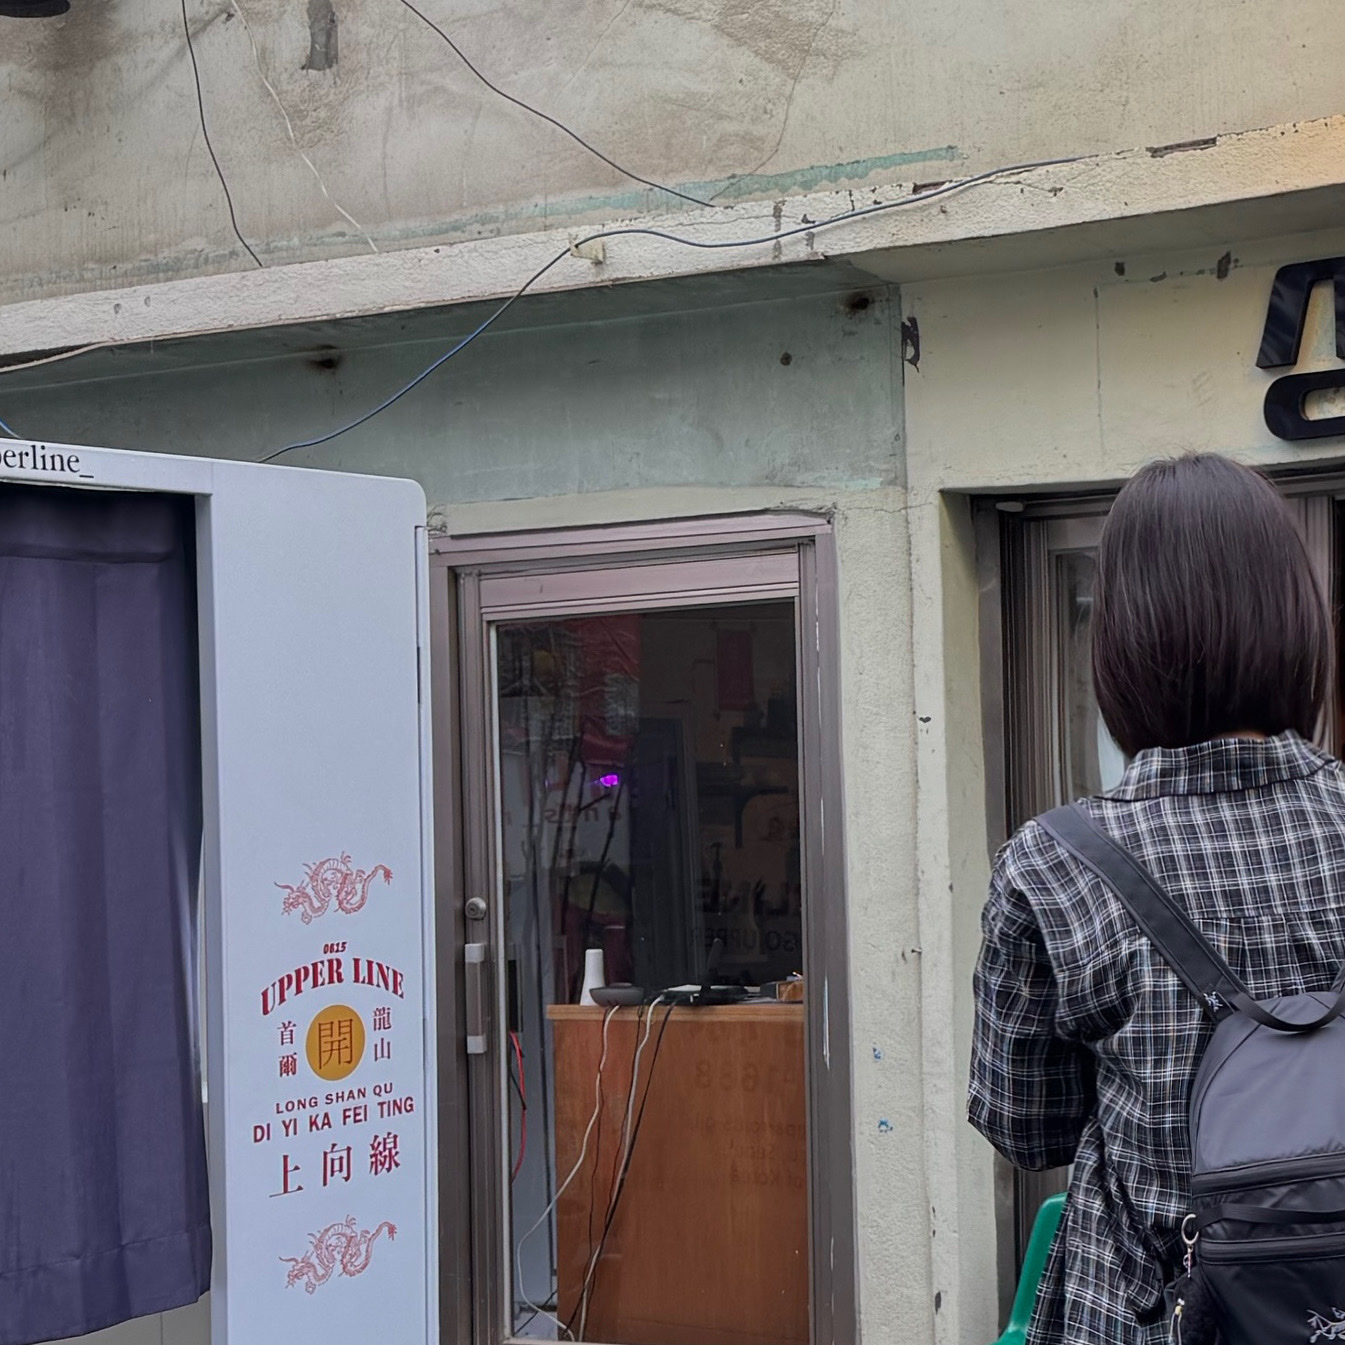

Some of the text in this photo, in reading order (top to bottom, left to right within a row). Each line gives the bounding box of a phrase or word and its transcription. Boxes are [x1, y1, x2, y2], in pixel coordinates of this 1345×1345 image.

[0, 444, 94, 479] erline_
[260, 957, 405, 1016] UPPER LINE
[317, 1018, 354, 1070] 開
[373, 1006, 393, 1062] 龍山
[253, 1096, 414, 1143] DI YI KA FEI TING
[276, 1082, 393, 1115] LONG SHAN QU
[269, 1131, 401, 1198] 上向線
